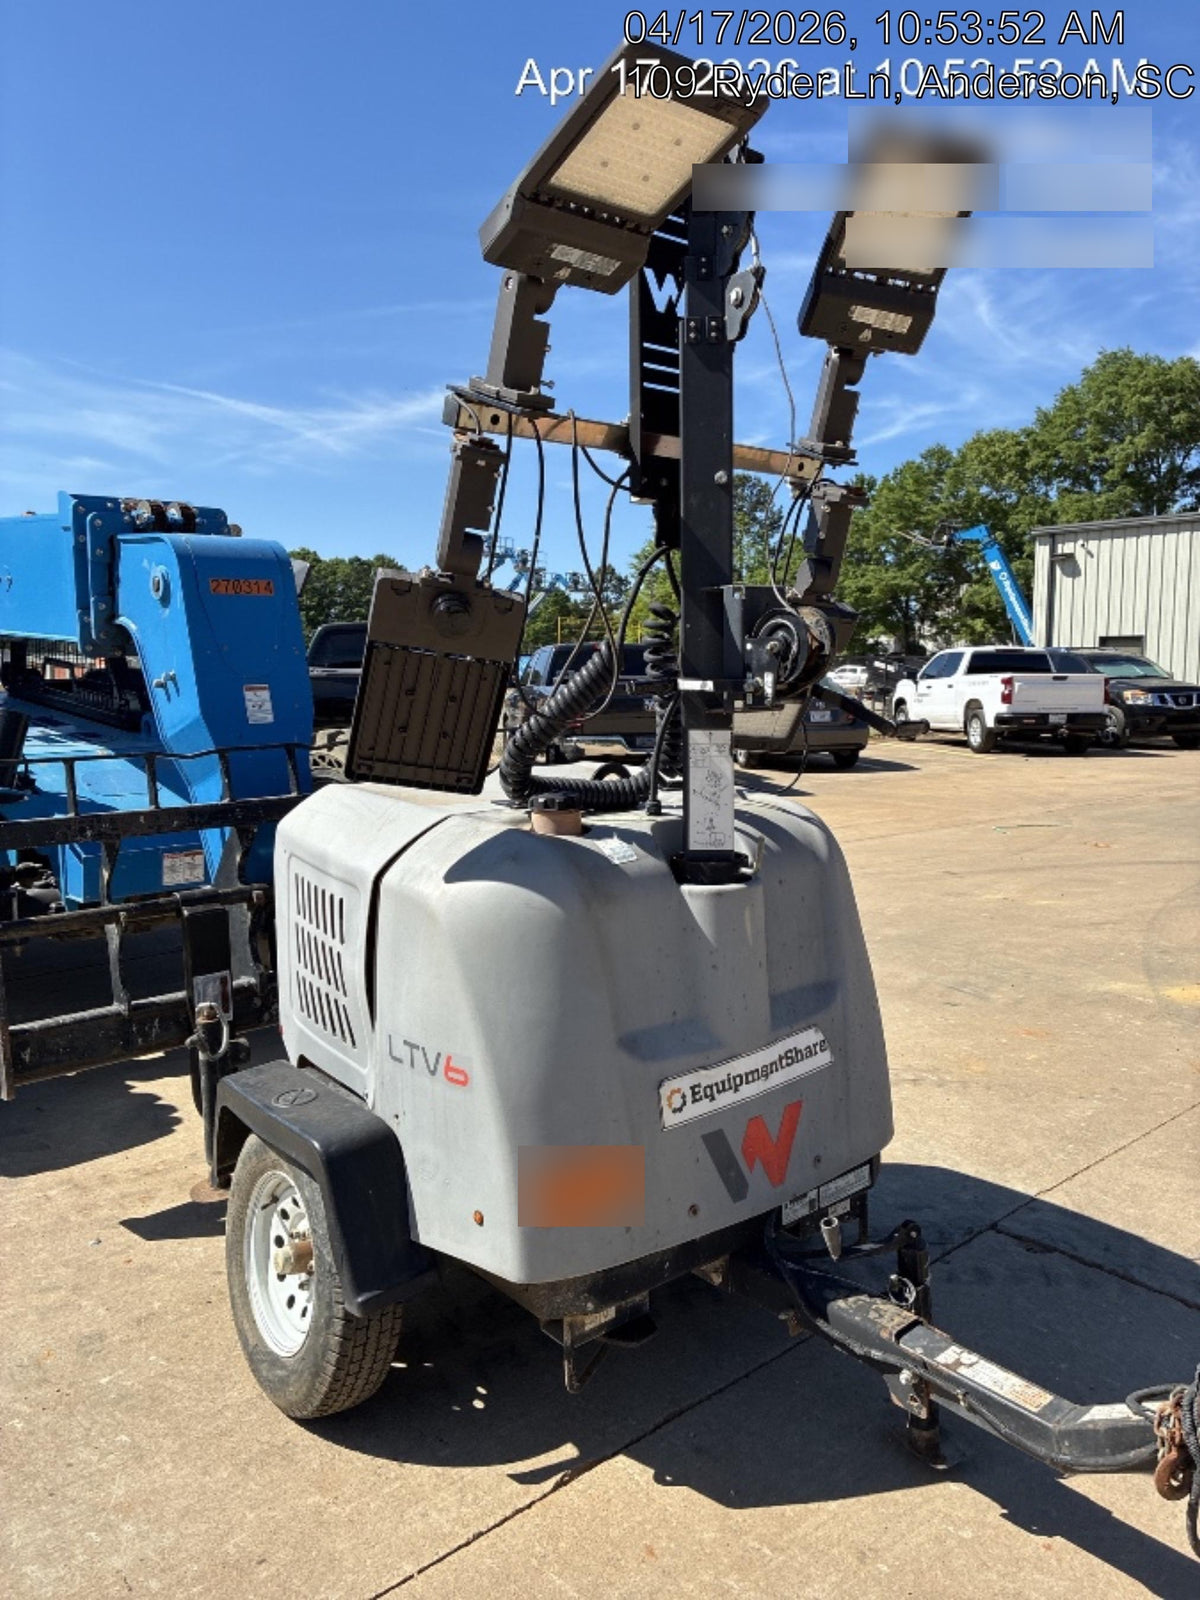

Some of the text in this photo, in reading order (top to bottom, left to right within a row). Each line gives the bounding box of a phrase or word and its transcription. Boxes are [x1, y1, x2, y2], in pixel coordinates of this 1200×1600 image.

[211, 578, 273, 595] 270314
[388, 1034, 469, 1087] LTV6
[689, 1039, 828, 1104] EquipmentShare
